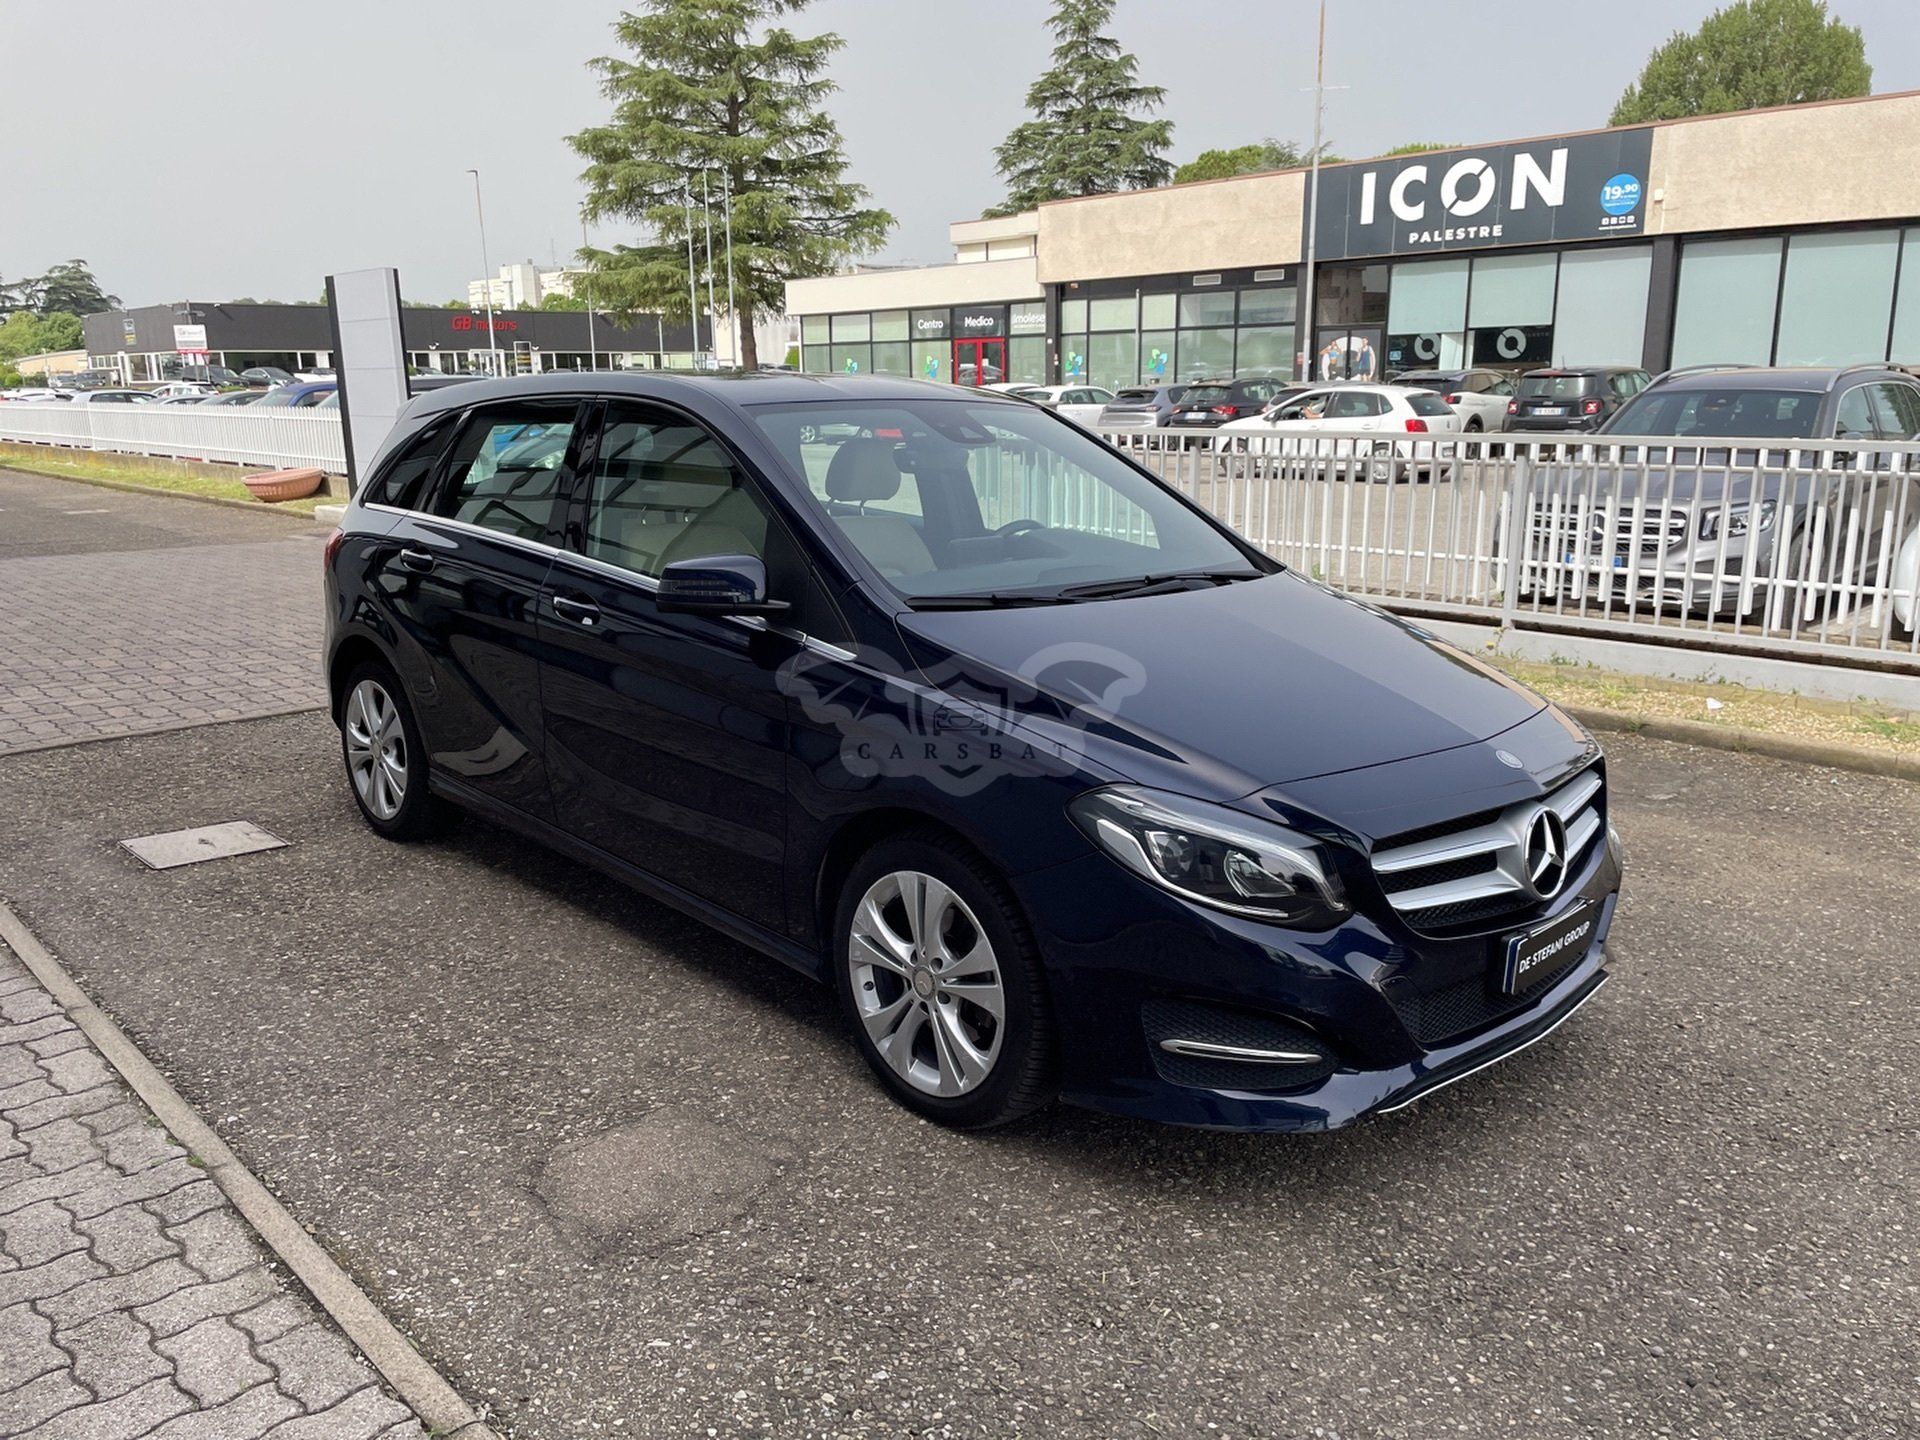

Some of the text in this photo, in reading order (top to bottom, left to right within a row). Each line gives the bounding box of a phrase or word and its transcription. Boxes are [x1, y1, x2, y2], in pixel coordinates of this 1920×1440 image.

[1360, 147, 1569, 225] ICON
[1408, 224, 1504, 244] PALESTRE
[452, 315, 472, 331] GB
[917, 318, 944, 329] Centro
[964, 315, 994, 327] Medico
[1519, 920, 1590, 973] DE STEFANI GROUP
